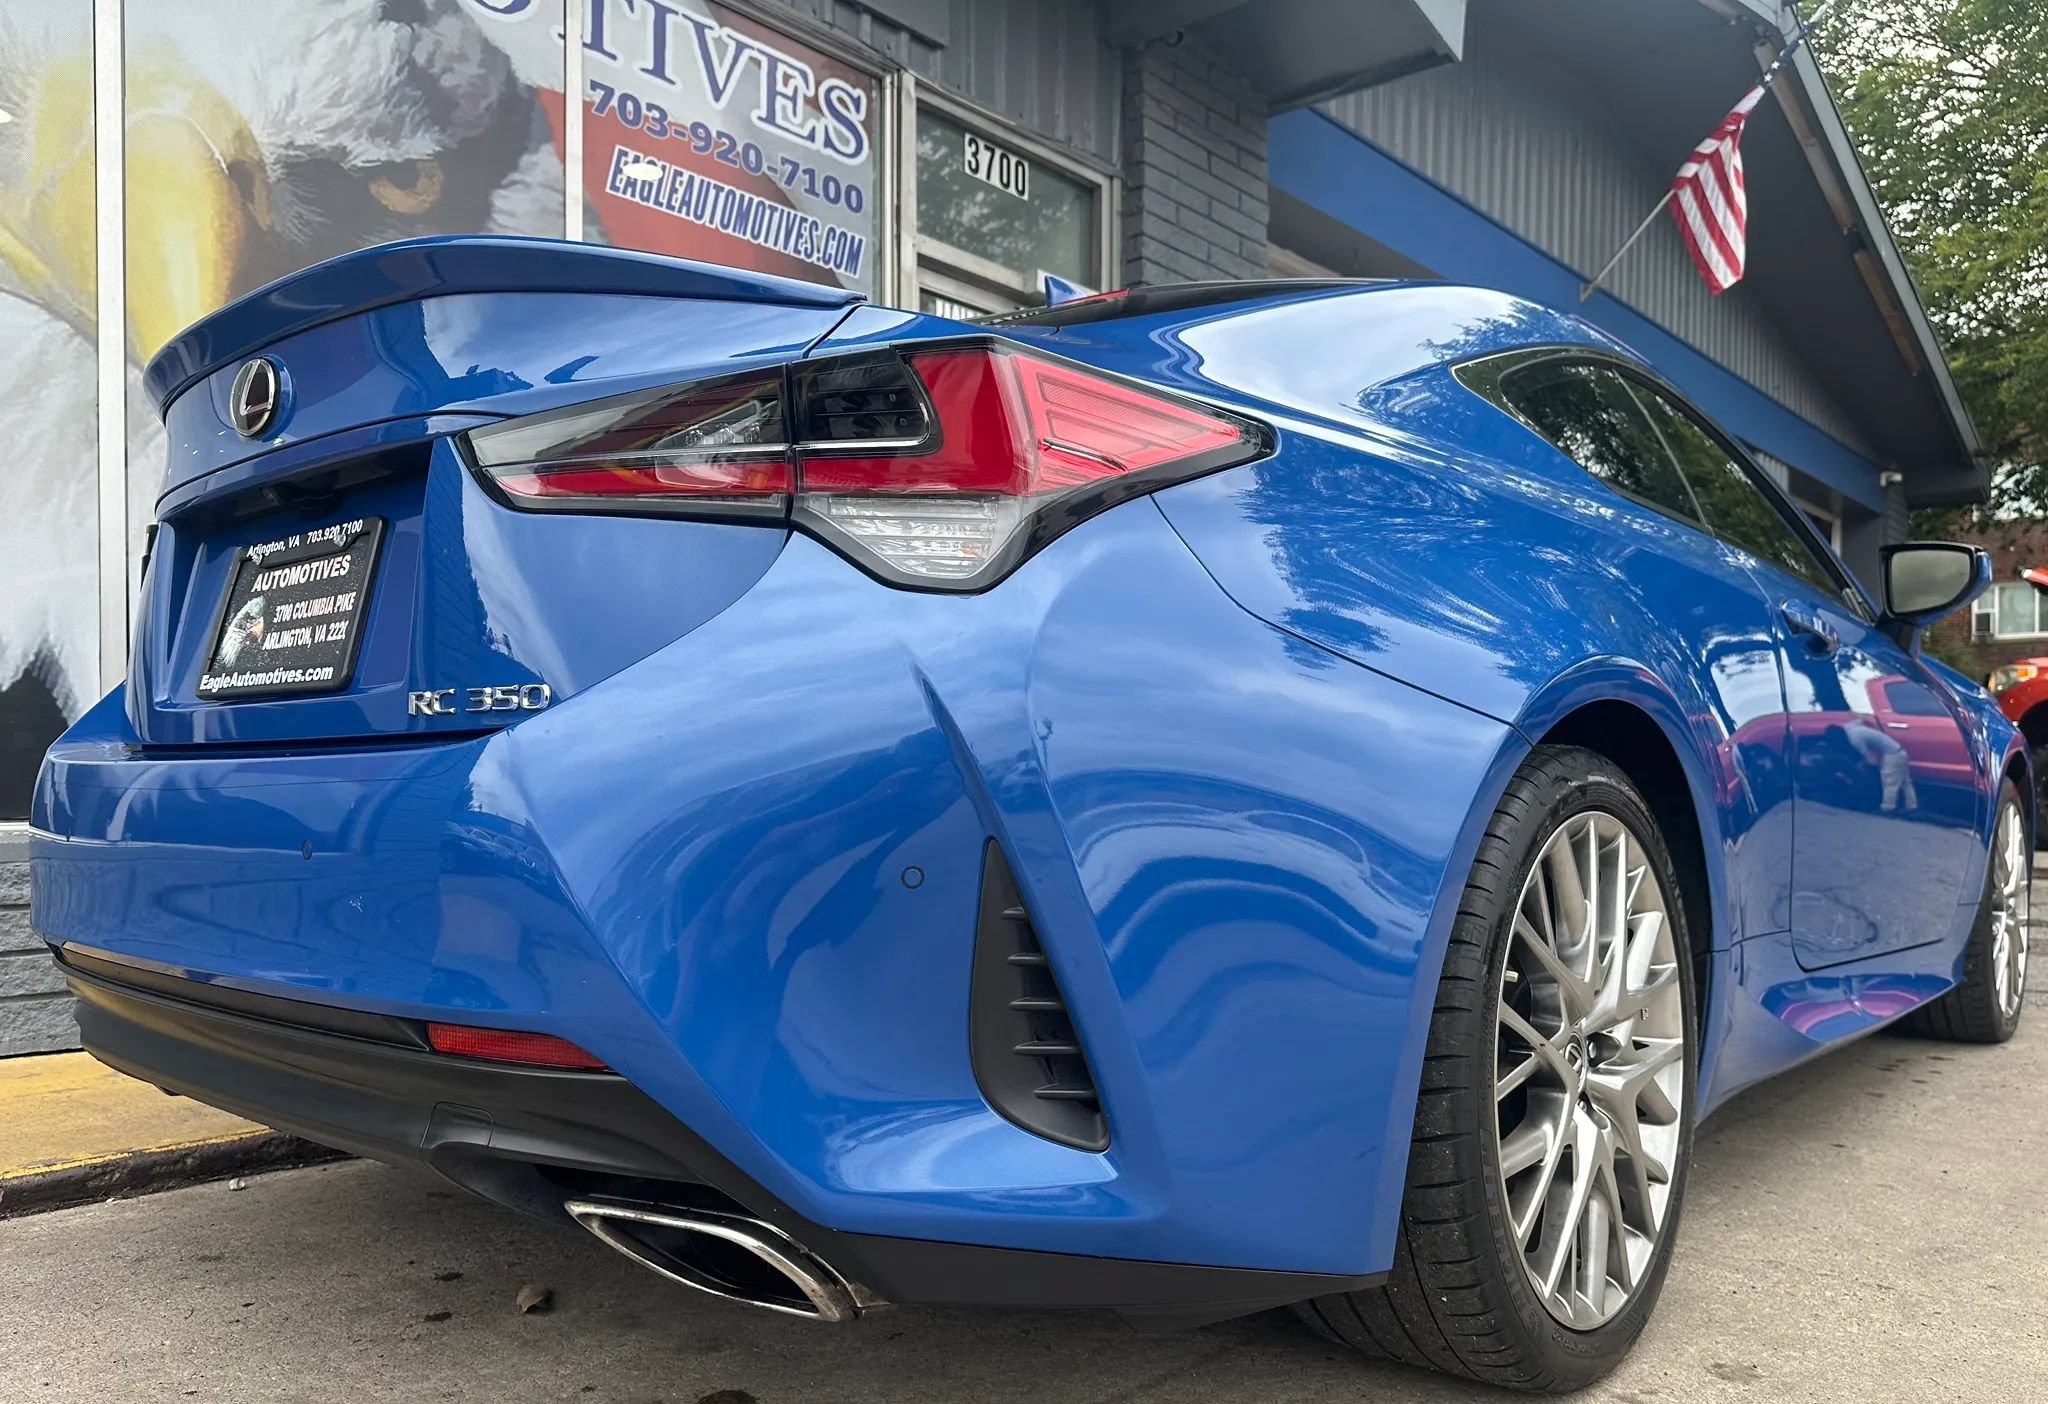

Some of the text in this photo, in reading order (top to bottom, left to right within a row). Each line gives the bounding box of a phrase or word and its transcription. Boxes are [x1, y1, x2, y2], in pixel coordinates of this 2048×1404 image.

[473, 0, 866, 160] TIVES
[589, 79, 865, 214] 703-920-7100
[967, 137, 1026, 197] 3700
[608, 148, 865, 276] EAGLEAUTOMOTIVES.COM
[288, 535, 300, 549] VA
[306, 519, 364, 545] 703.9207100
[251, 554, 352, 593] AUTOMOTIVES
[273, 592, 356, 624] 3700 COLUMBIA PIKE
[262, 625, 313, 651] ARLINGTON,
[314, 623, 327, 644] VA
[200, 666, 334, 693] EagleAutomotives.com
[408, 683, 552, 717] RC 350
